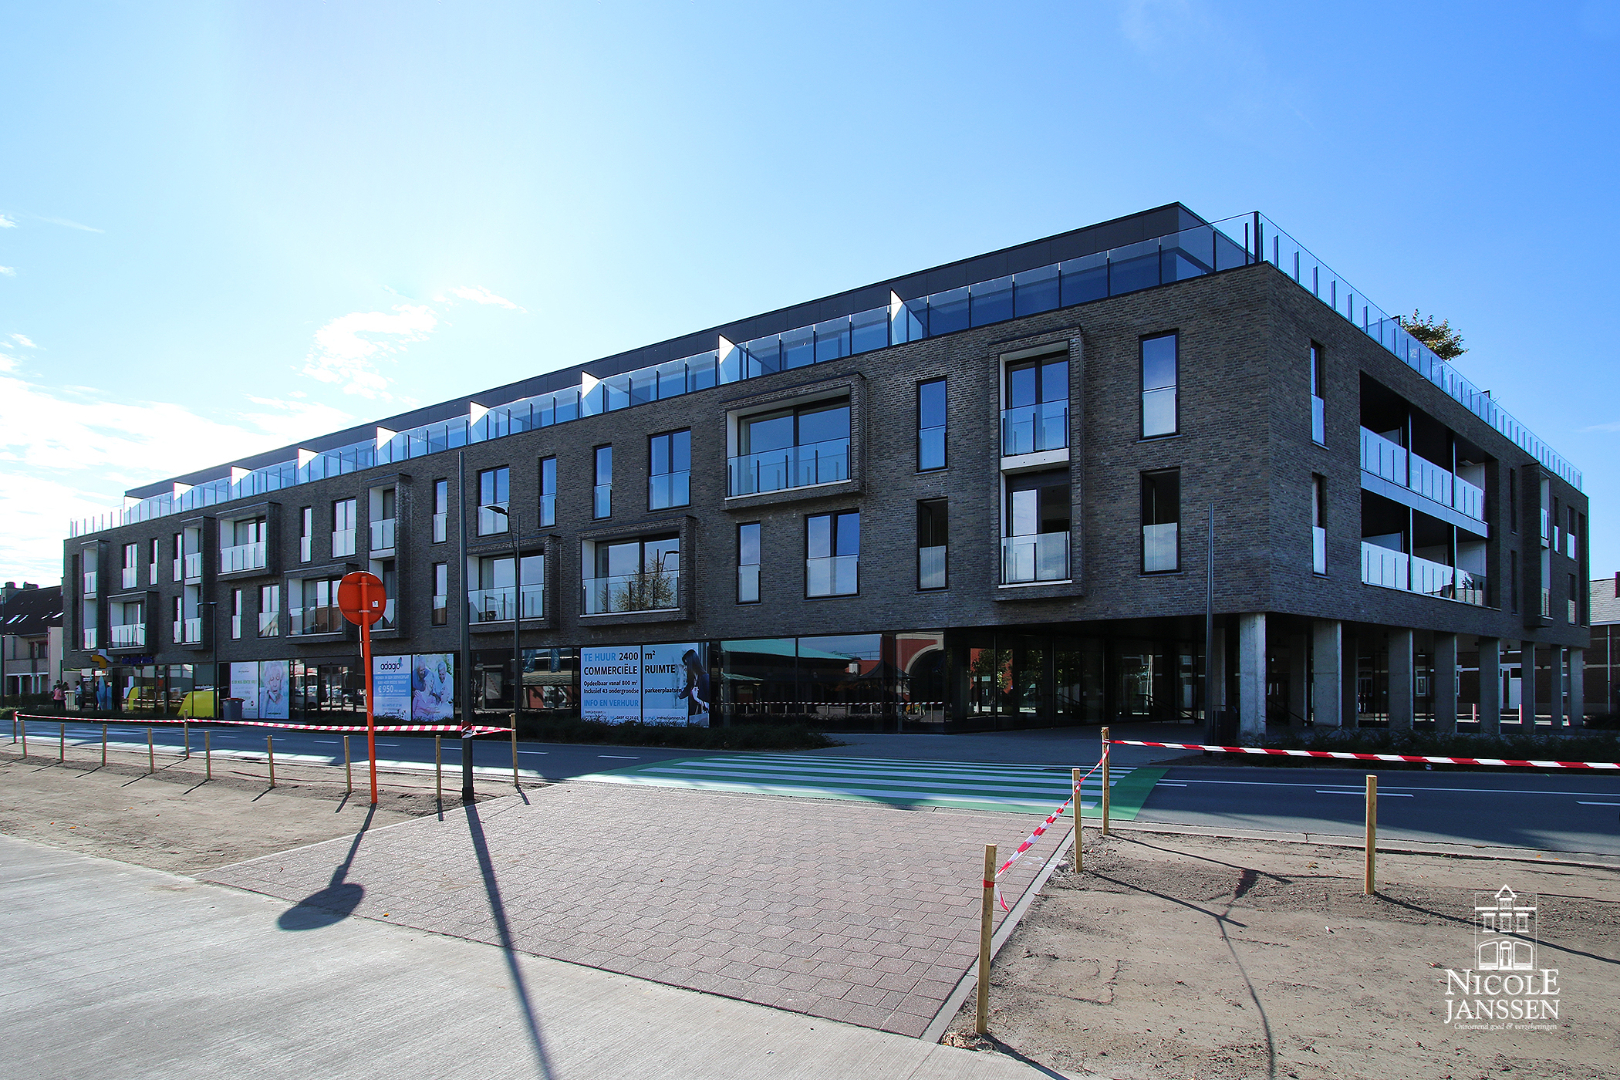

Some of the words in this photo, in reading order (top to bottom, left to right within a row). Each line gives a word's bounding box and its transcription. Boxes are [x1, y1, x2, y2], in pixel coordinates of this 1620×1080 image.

[584, 653, 592, 662] TE
[595, 652, 616, 661] HUUR
[618, 652, 639, 661] 2400
[380, 661, 401, 672] adagio
[583, 663, 638, 676] COMMERCIËLE
[645, 664, 676, 674] RUIMTE
[382, 685, 394, 693] 950
[584, 699, 598, 707] INFO
[600, 699, 608, 707] EN
[609, 699, 639, 707] VERHUUR
